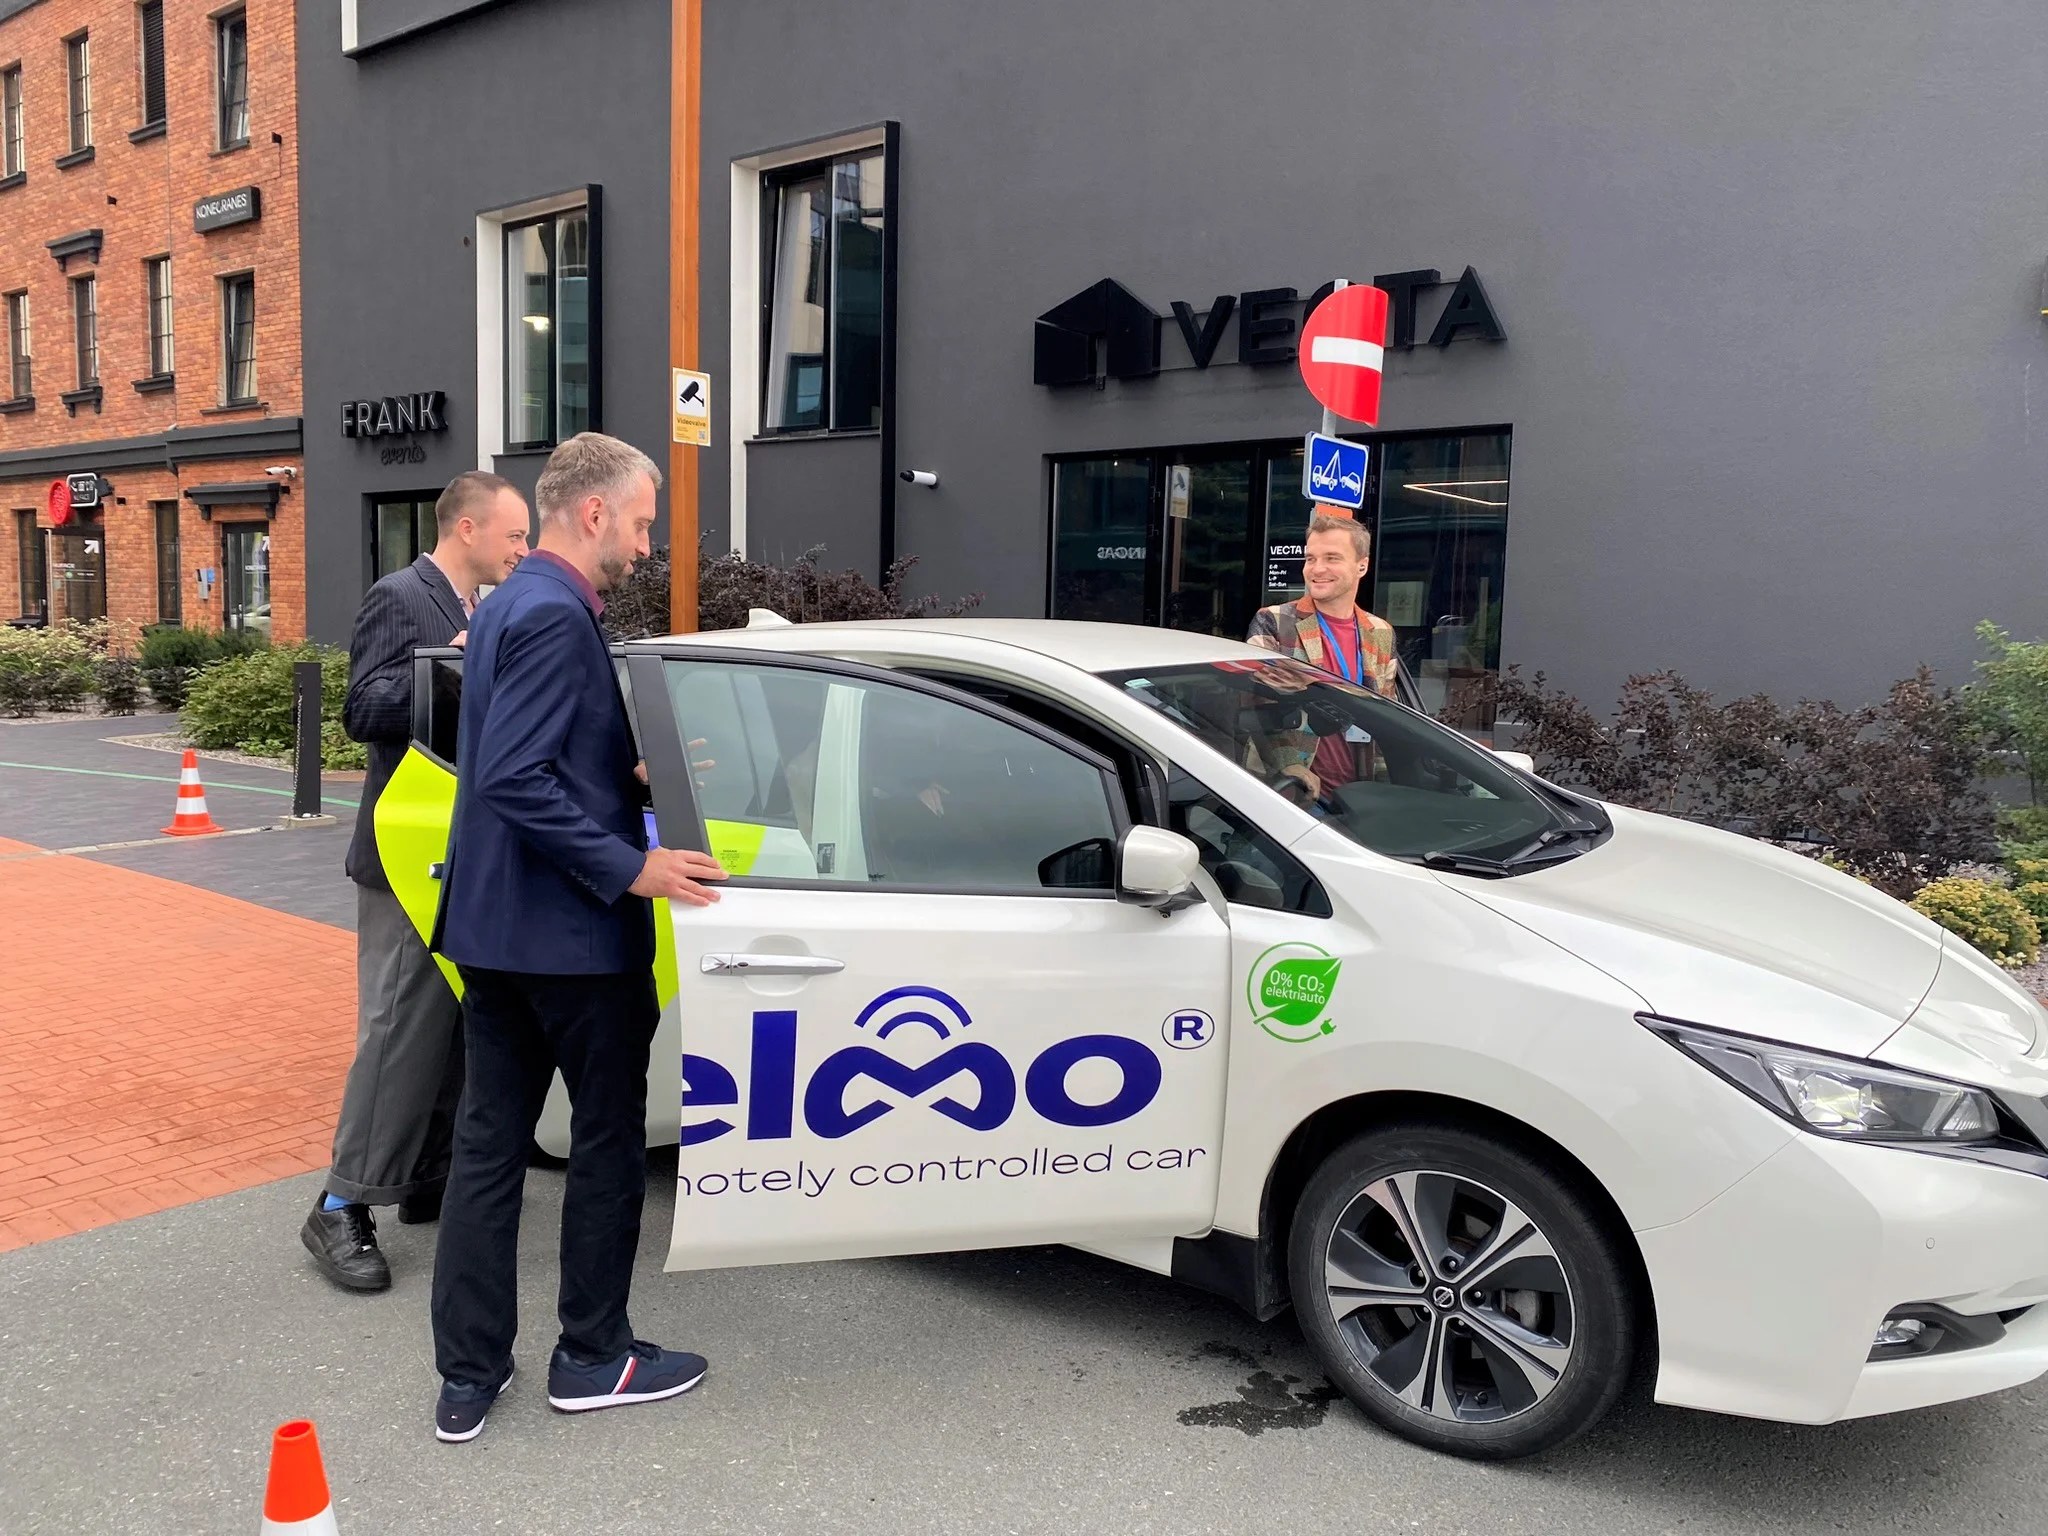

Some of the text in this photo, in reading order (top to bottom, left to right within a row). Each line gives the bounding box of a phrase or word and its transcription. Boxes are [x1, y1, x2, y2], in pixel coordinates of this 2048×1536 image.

[1170, 265, 1508, 369] VETA
[341, 391, 446, 438] FRANK
[677, 417, 706, 427] Videovalve
[381, 441, 427, 466] events
[1270, 545, 1302, 555] VECTA
[1270, 969, 1293, 988] 0%
[1265, 985, 1326, 1005] elektriauto
[849, 1144, 1113, 1187] controlled
[1126, 1145, 1207, 1172] car
